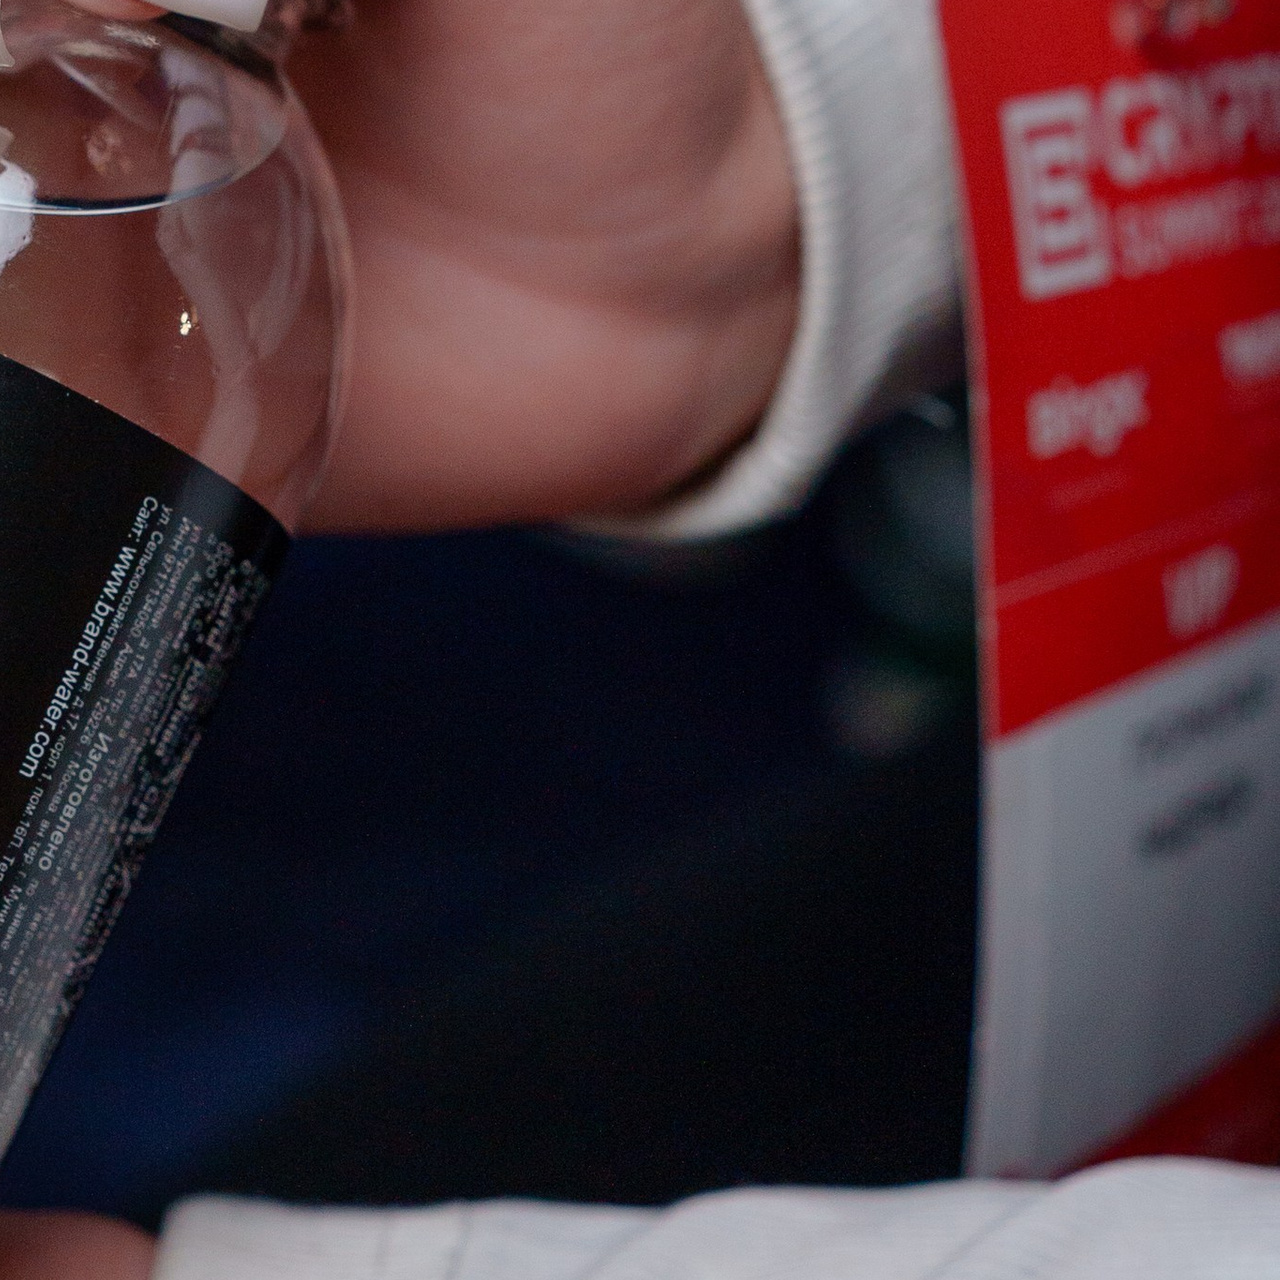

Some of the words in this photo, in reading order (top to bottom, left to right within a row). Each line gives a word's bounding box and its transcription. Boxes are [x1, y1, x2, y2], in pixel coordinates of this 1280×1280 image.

[129, 496, 158, 541] Сайт:
[20, 545, 138, 779] www.brand-water.com
[38, 732, 113, 871] Изготовлено
